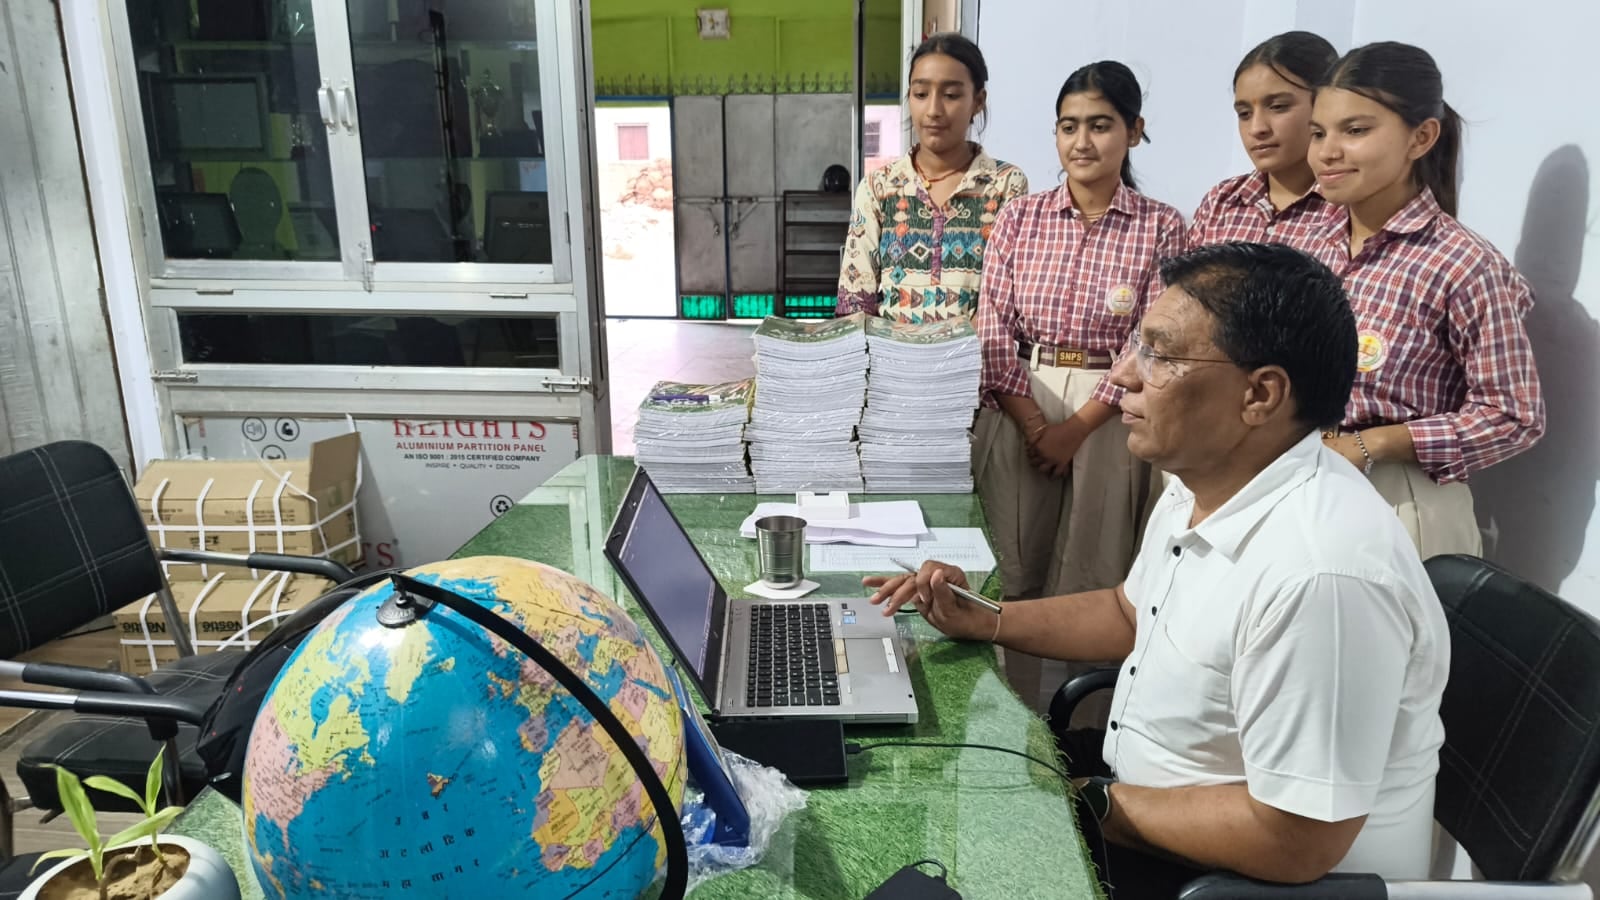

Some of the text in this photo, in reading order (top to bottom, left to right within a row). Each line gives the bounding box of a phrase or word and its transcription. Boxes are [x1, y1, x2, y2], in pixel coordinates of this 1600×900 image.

[1060, 351, 1082, 361] SNPS
[396, 442, 546, 452] ALUMINIUM PARTITION PANEL
